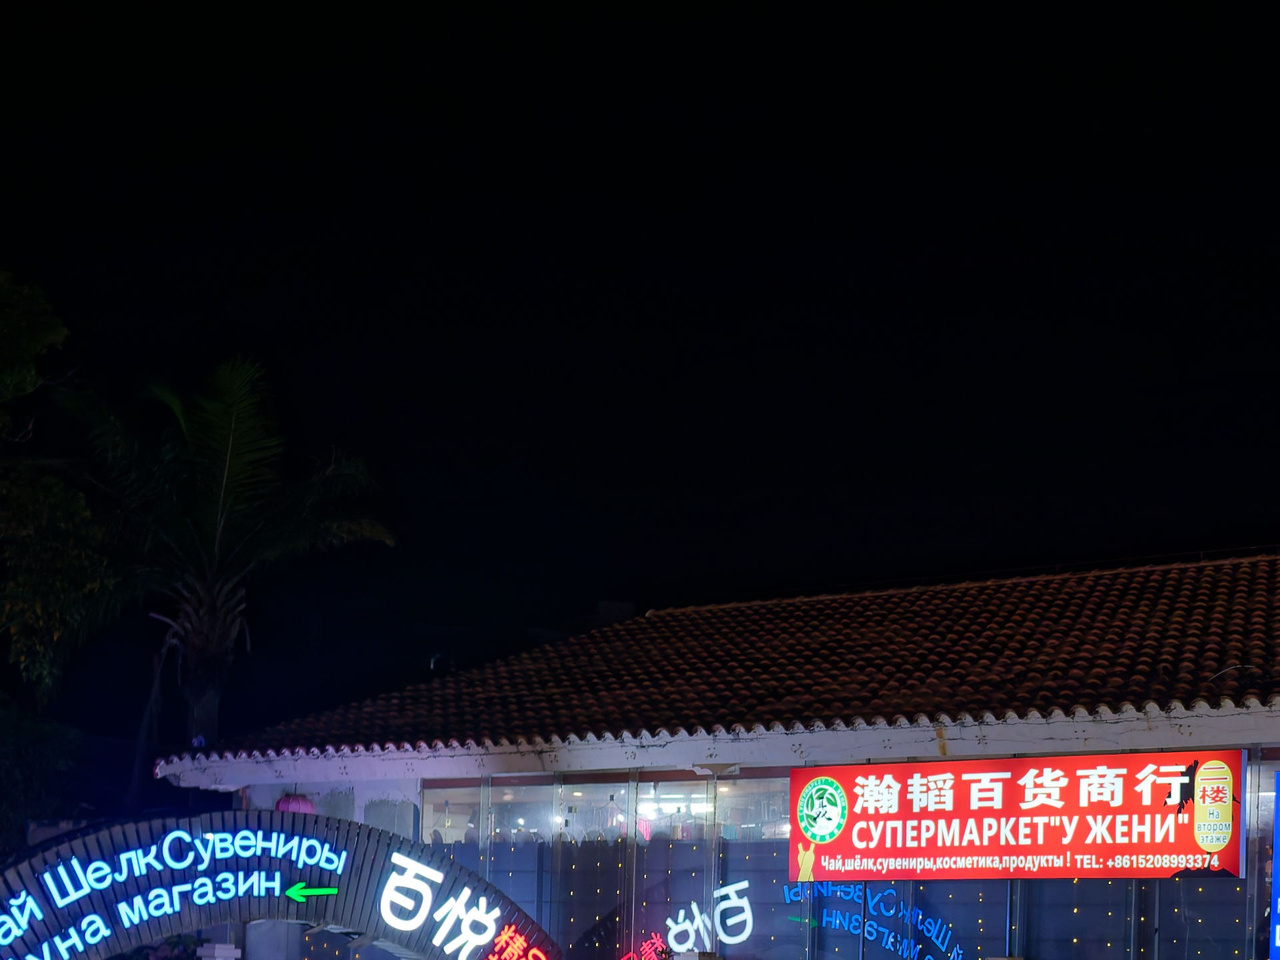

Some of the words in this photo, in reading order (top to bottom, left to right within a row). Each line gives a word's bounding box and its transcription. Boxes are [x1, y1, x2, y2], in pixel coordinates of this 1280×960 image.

[852, 763, 1190, 816] 瀚韬百货商行
[1197, 766, 1230, 806] 二楼
[1085, 814, 1189, 845] ЖЕНИ"
[1197, 822, 1231, 835] втором
[1208, 808, 1220, 820] На
[162, 829, 347, 875] Сувениры
[1200, 834, 1228, 844] этаже
[1074, 854, 1103, 868] TEL:
[1105, 851, 1220, 869] +8615208993374
[116, 869, 281, 929] магазин
